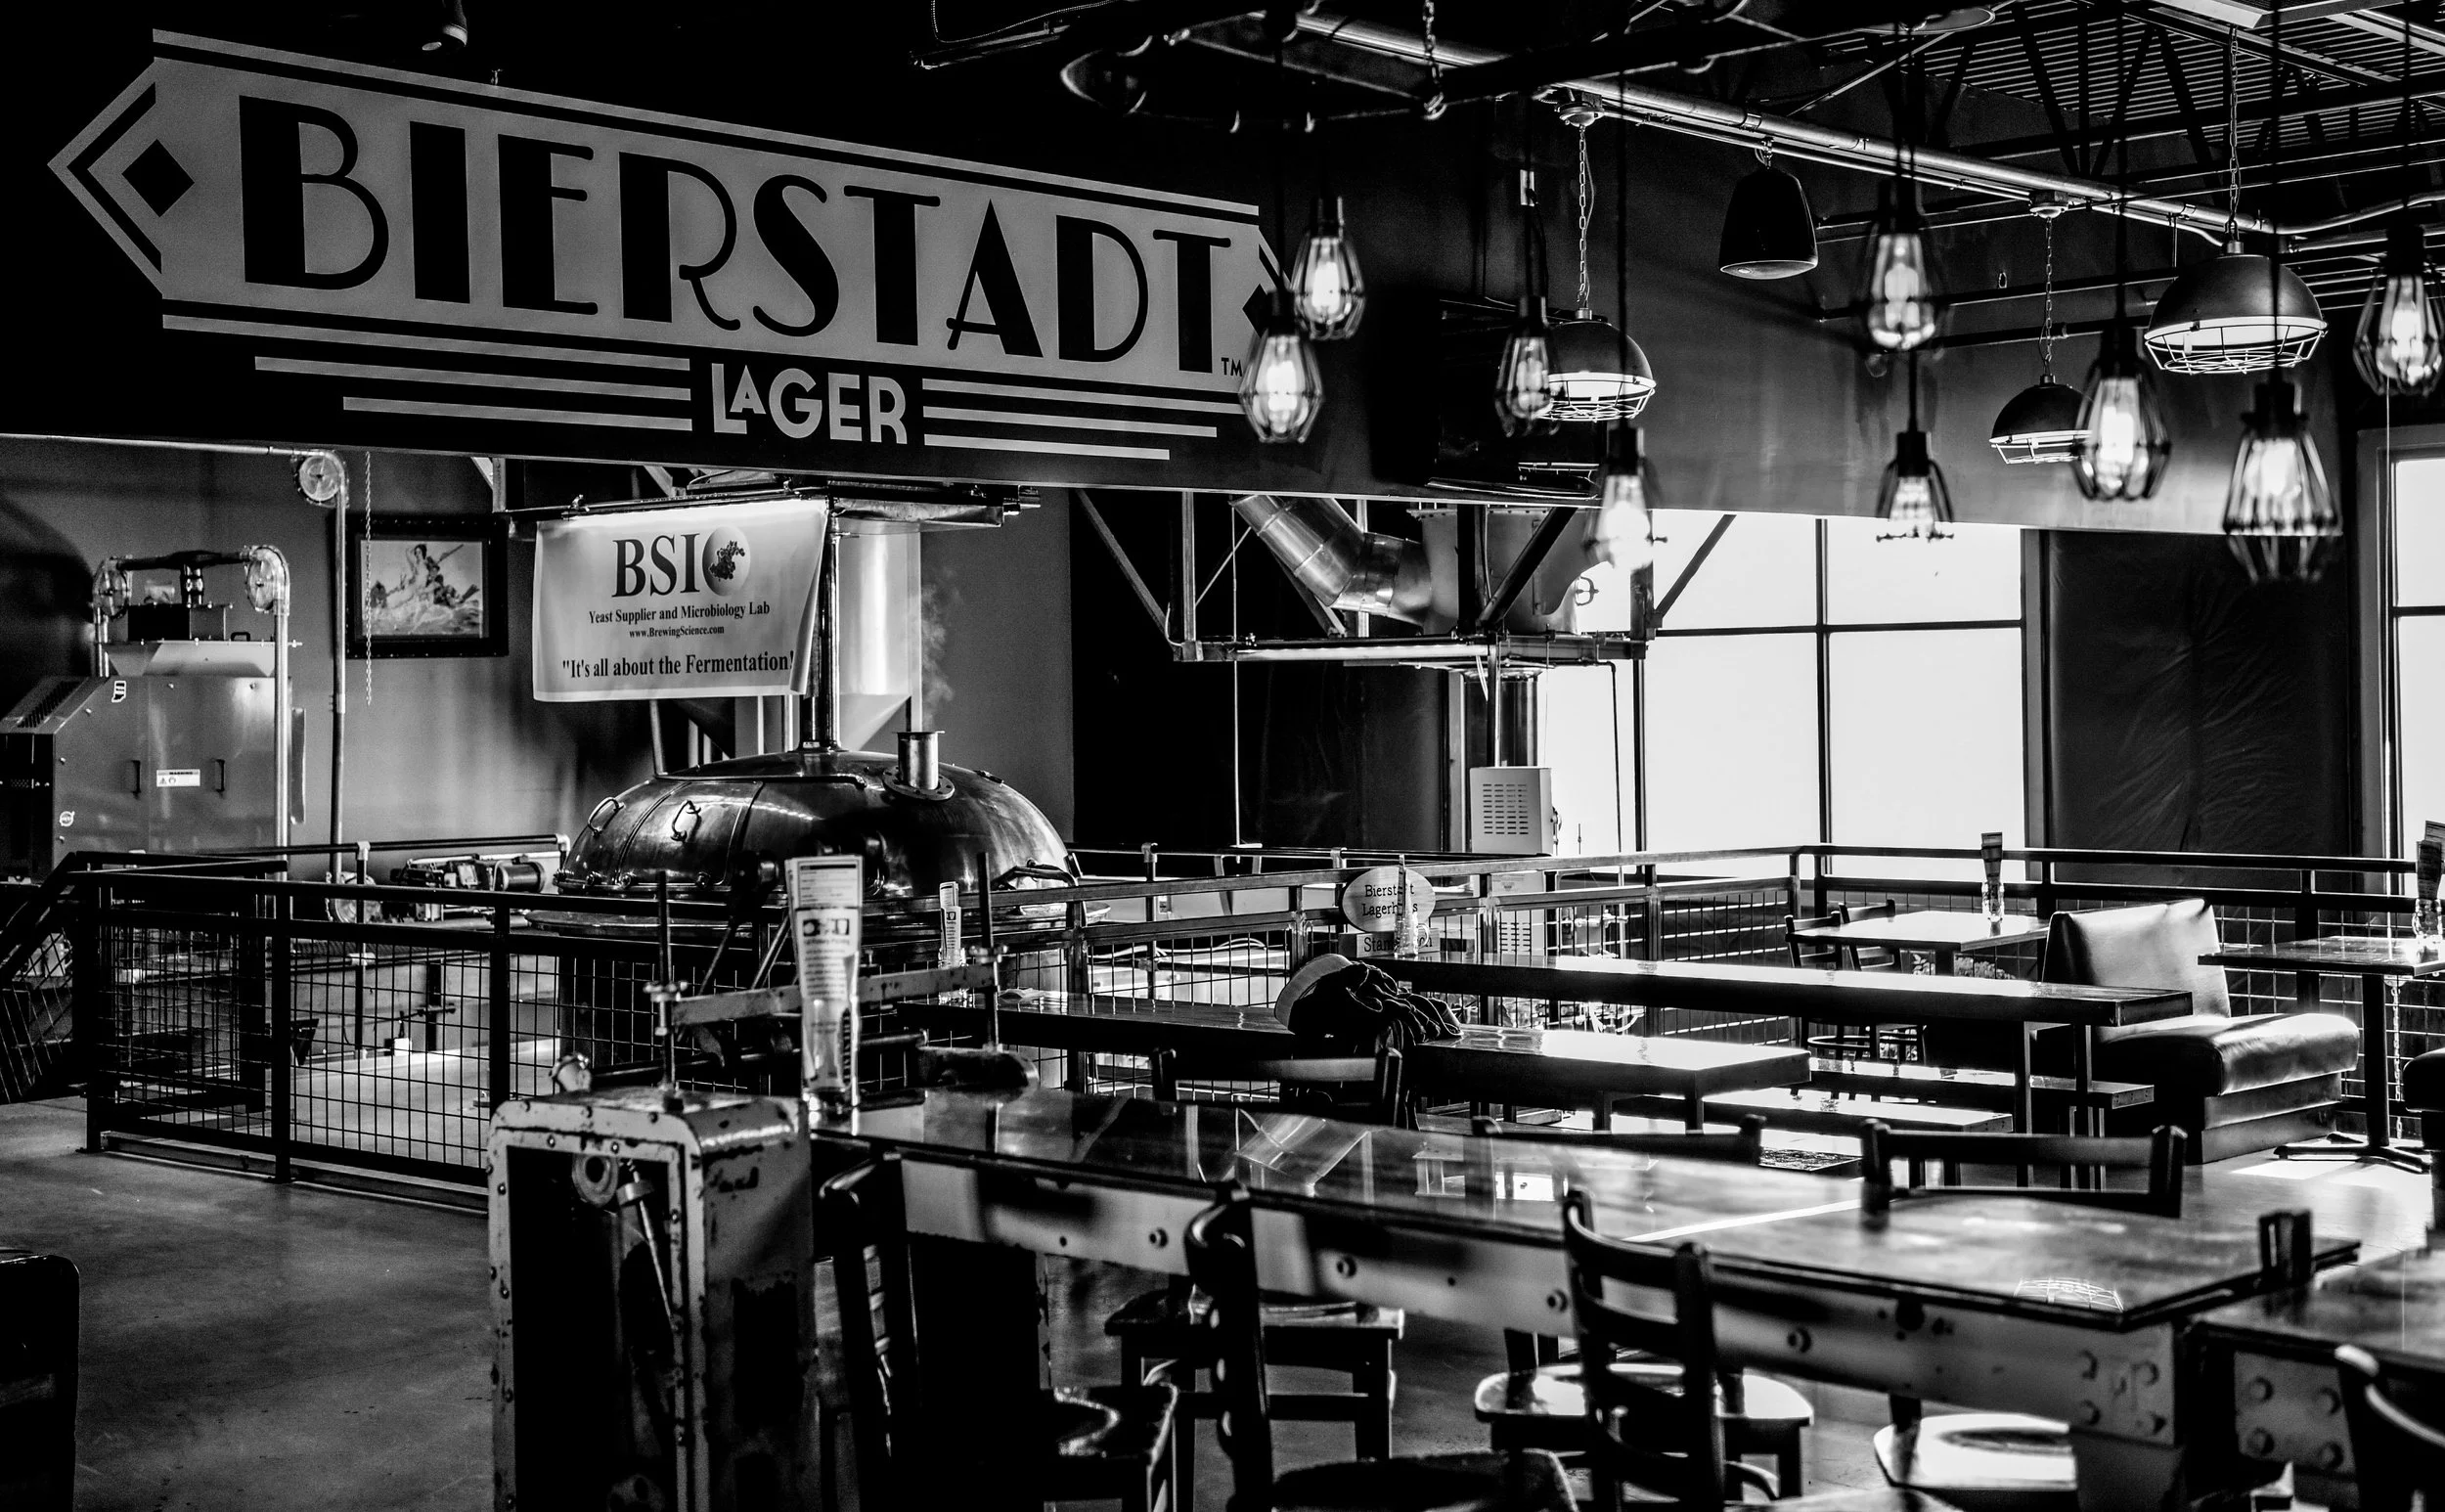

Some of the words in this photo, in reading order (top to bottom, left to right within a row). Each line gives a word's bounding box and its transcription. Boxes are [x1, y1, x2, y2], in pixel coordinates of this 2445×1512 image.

[238, 94, 1231, 374] BIERSTADT
[1221, 357, 1243, 378] TM
[712, 362, 908, 445] LAGER
[611, 533, 700, 598] BSI
[589, 610, 613, 624] Yeast
[615, 608, 657, 625] Supplier
[659, 606, 678, 620] and
[681, 602, 746, 619] Microbiology
[749, 600, 770, 615] Lab
[629, 625, 725, 639] www.BrewingScience.com
[594, 657, 609, 677] all
[613, 656, 654, 677] about
[658, 655, 682, 675] the
[1364, 883, 1415, 897] Bierstt
[1361, 901, 1418, 918] Lagerhs
